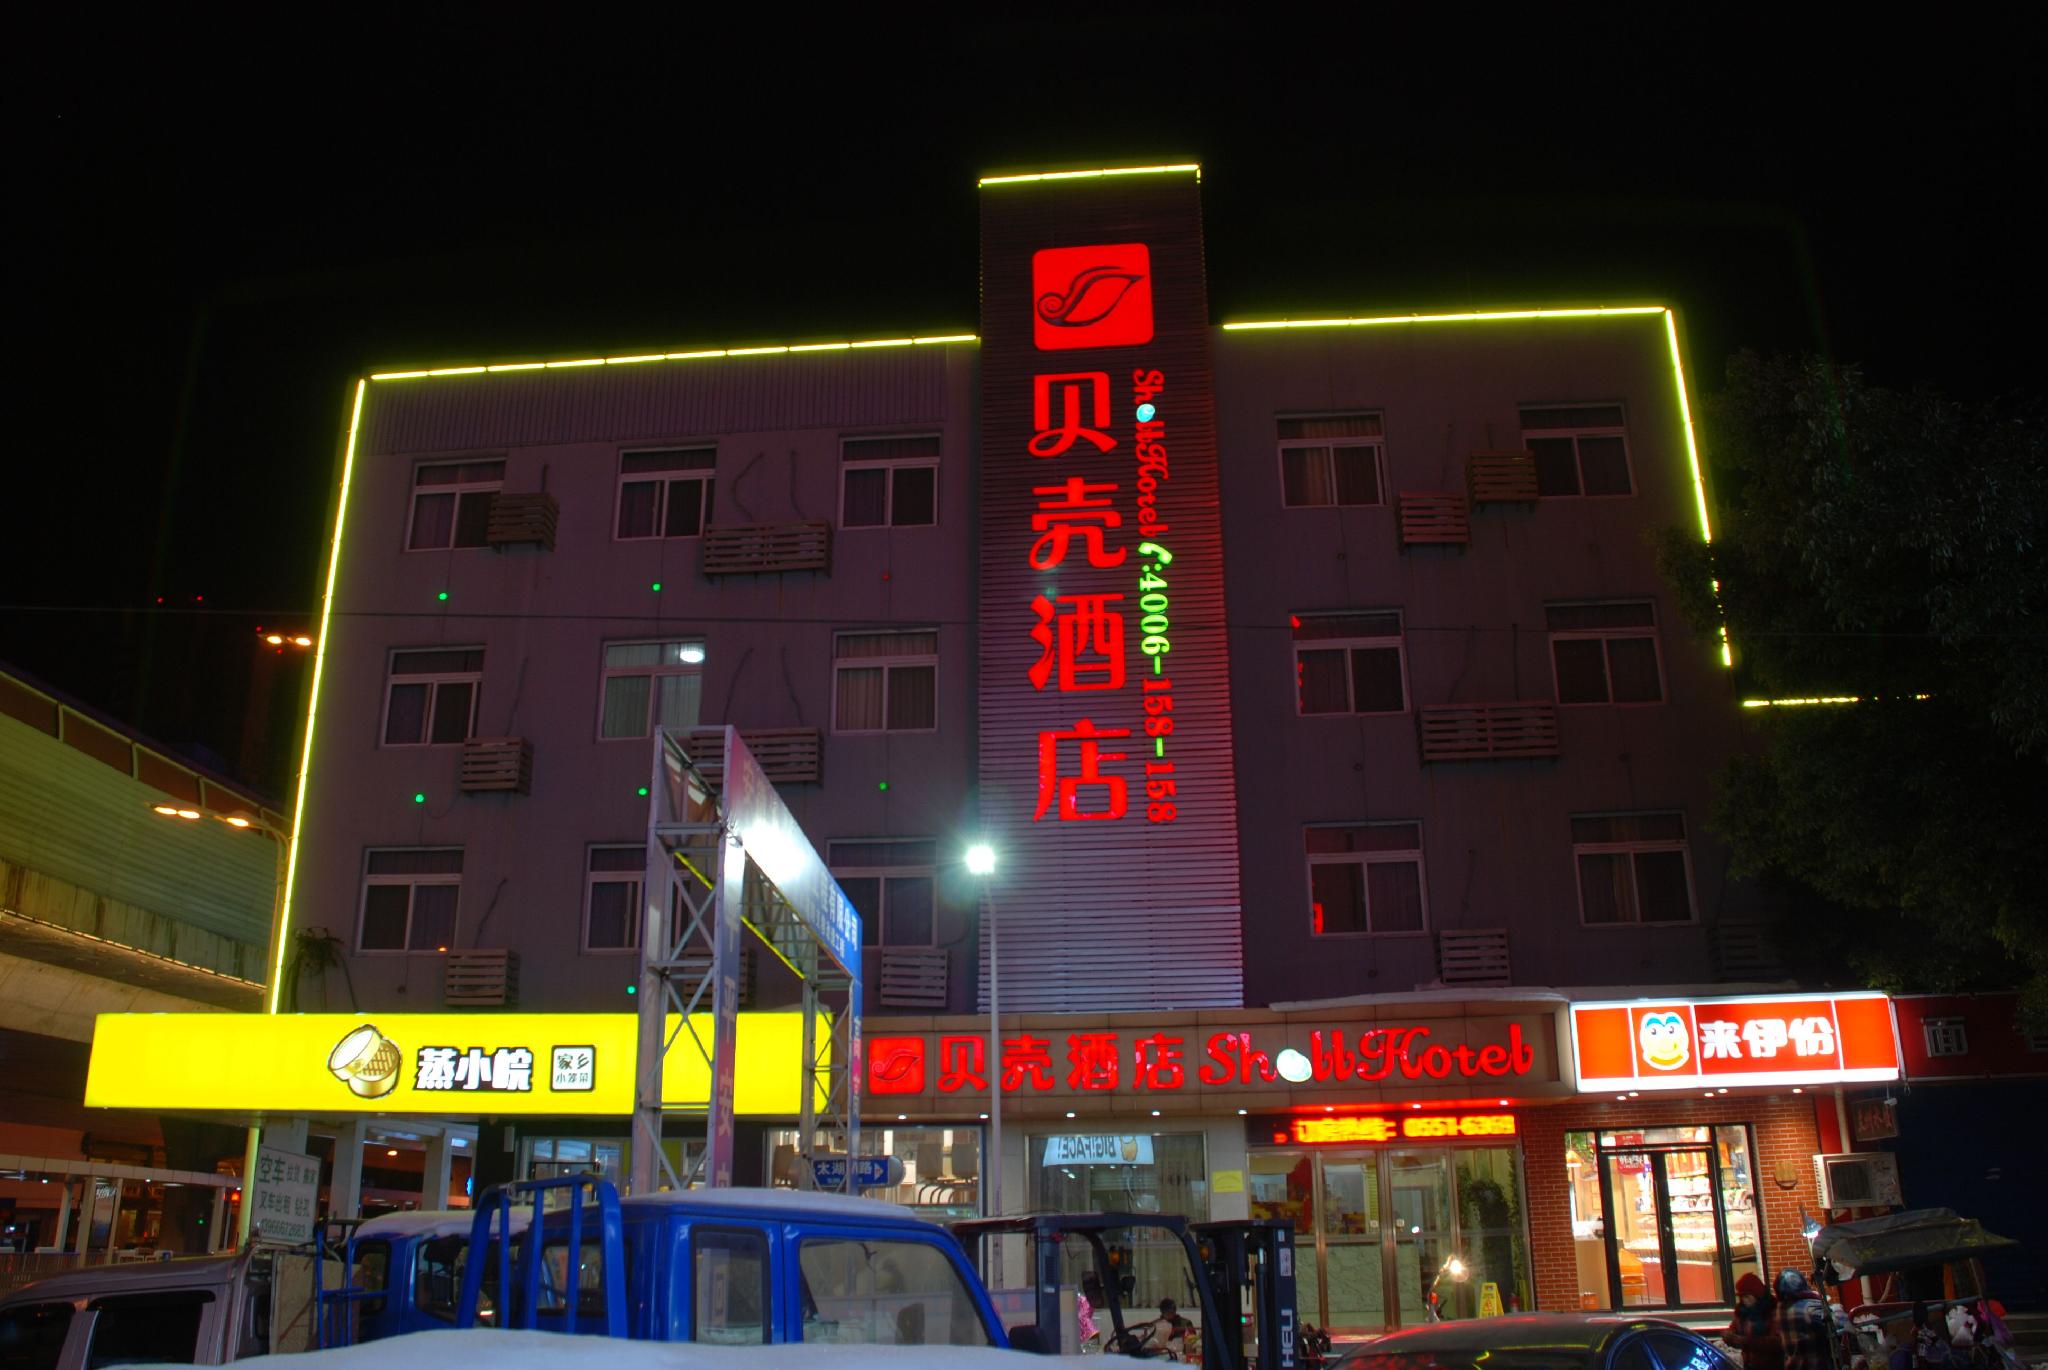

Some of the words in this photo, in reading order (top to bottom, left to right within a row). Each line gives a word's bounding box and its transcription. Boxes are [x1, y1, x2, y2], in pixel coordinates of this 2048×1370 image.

[1028, 371, 1131, 822] 贝壳酒店
[1700, 1017, 1835, 1058] 来伊份
[937, 1032, 1184, 1092] 贝壳酒店
[259, 1153, 286, 1186] 空车
[817, 1161, 873, 1175] 太湖路
